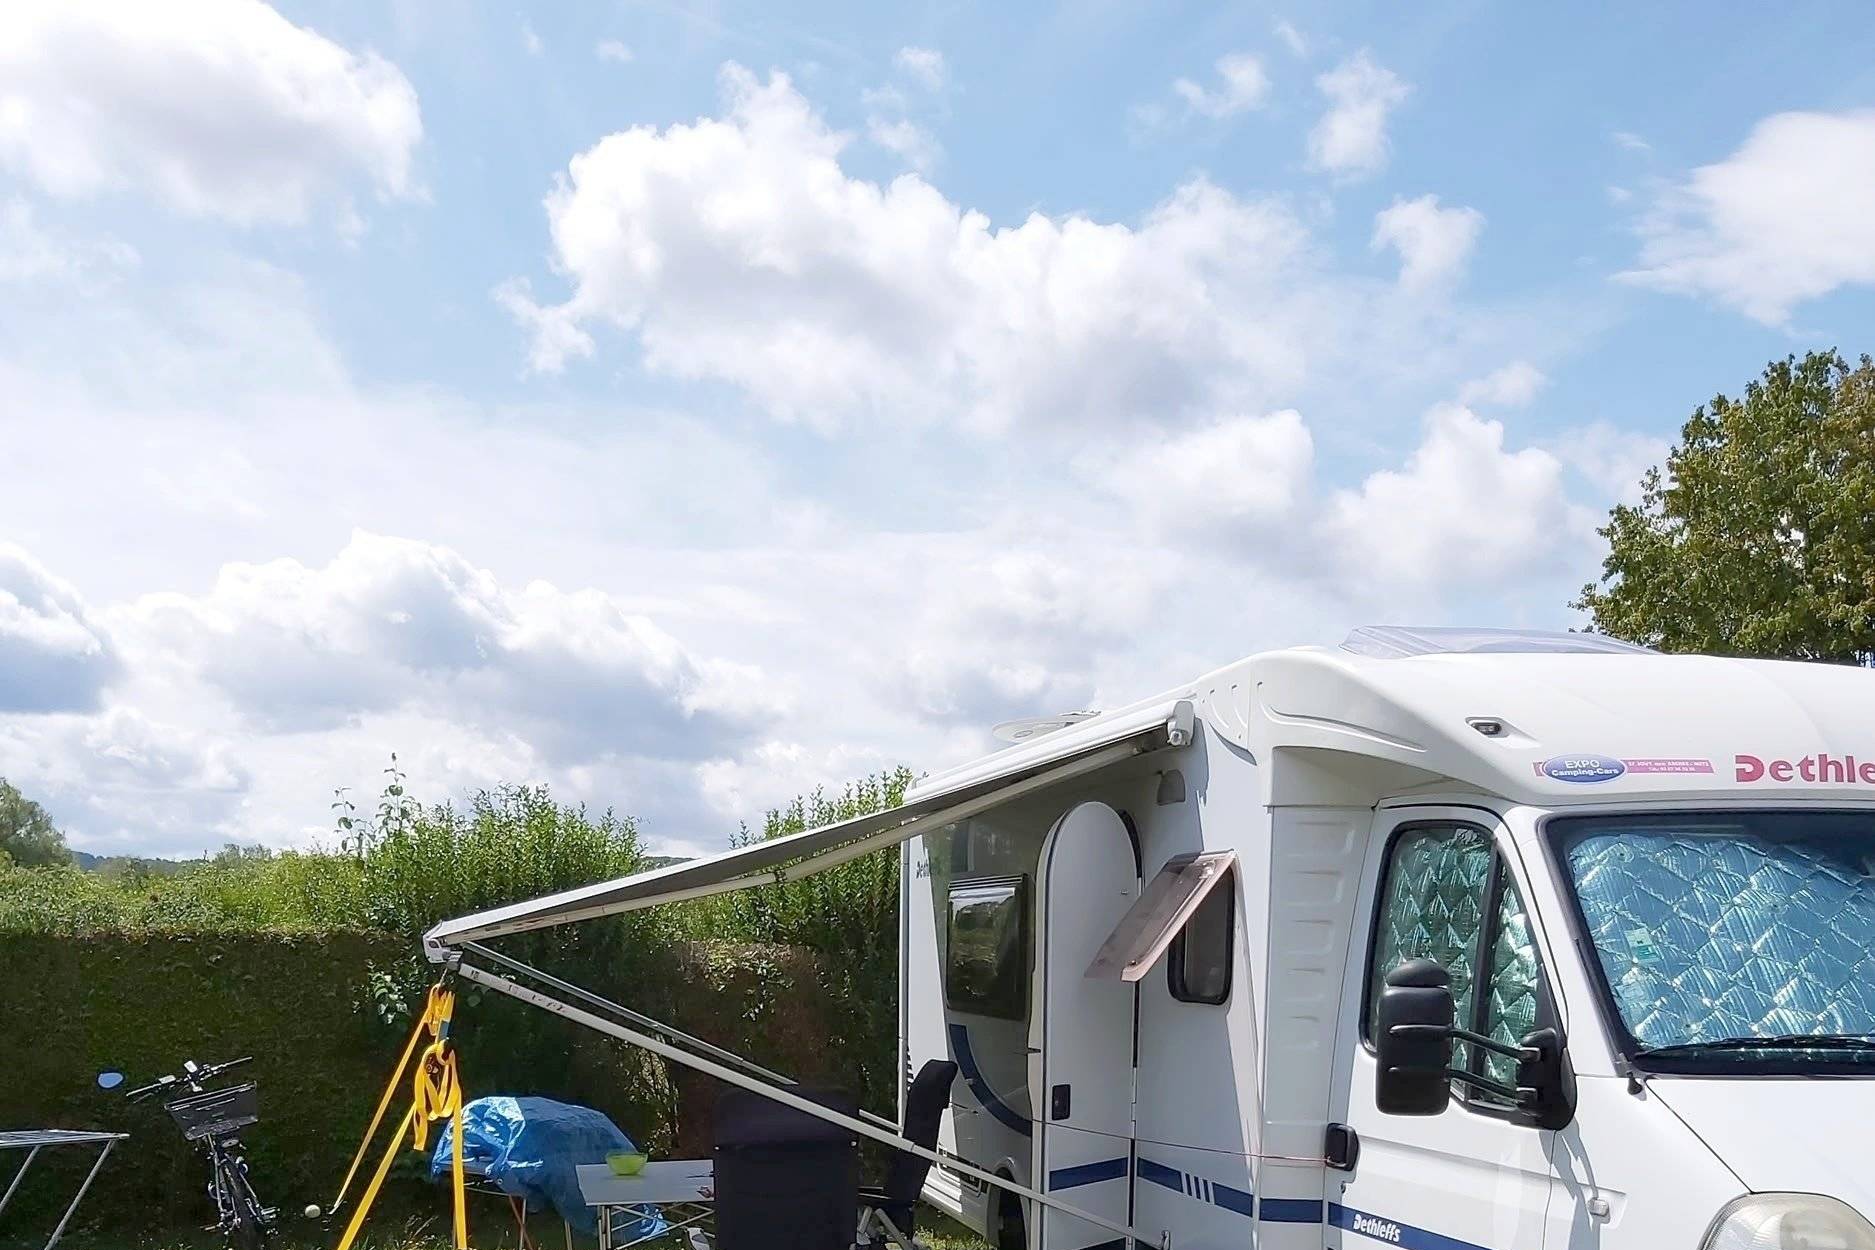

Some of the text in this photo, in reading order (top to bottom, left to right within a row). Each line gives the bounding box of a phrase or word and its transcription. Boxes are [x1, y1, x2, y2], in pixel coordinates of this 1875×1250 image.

[1565, 759, 1600, 770] EXPO
[1551, 767, 1619, 777] Camping-Cars
[1353, 1213, 1401, 1243] Dethleffs
